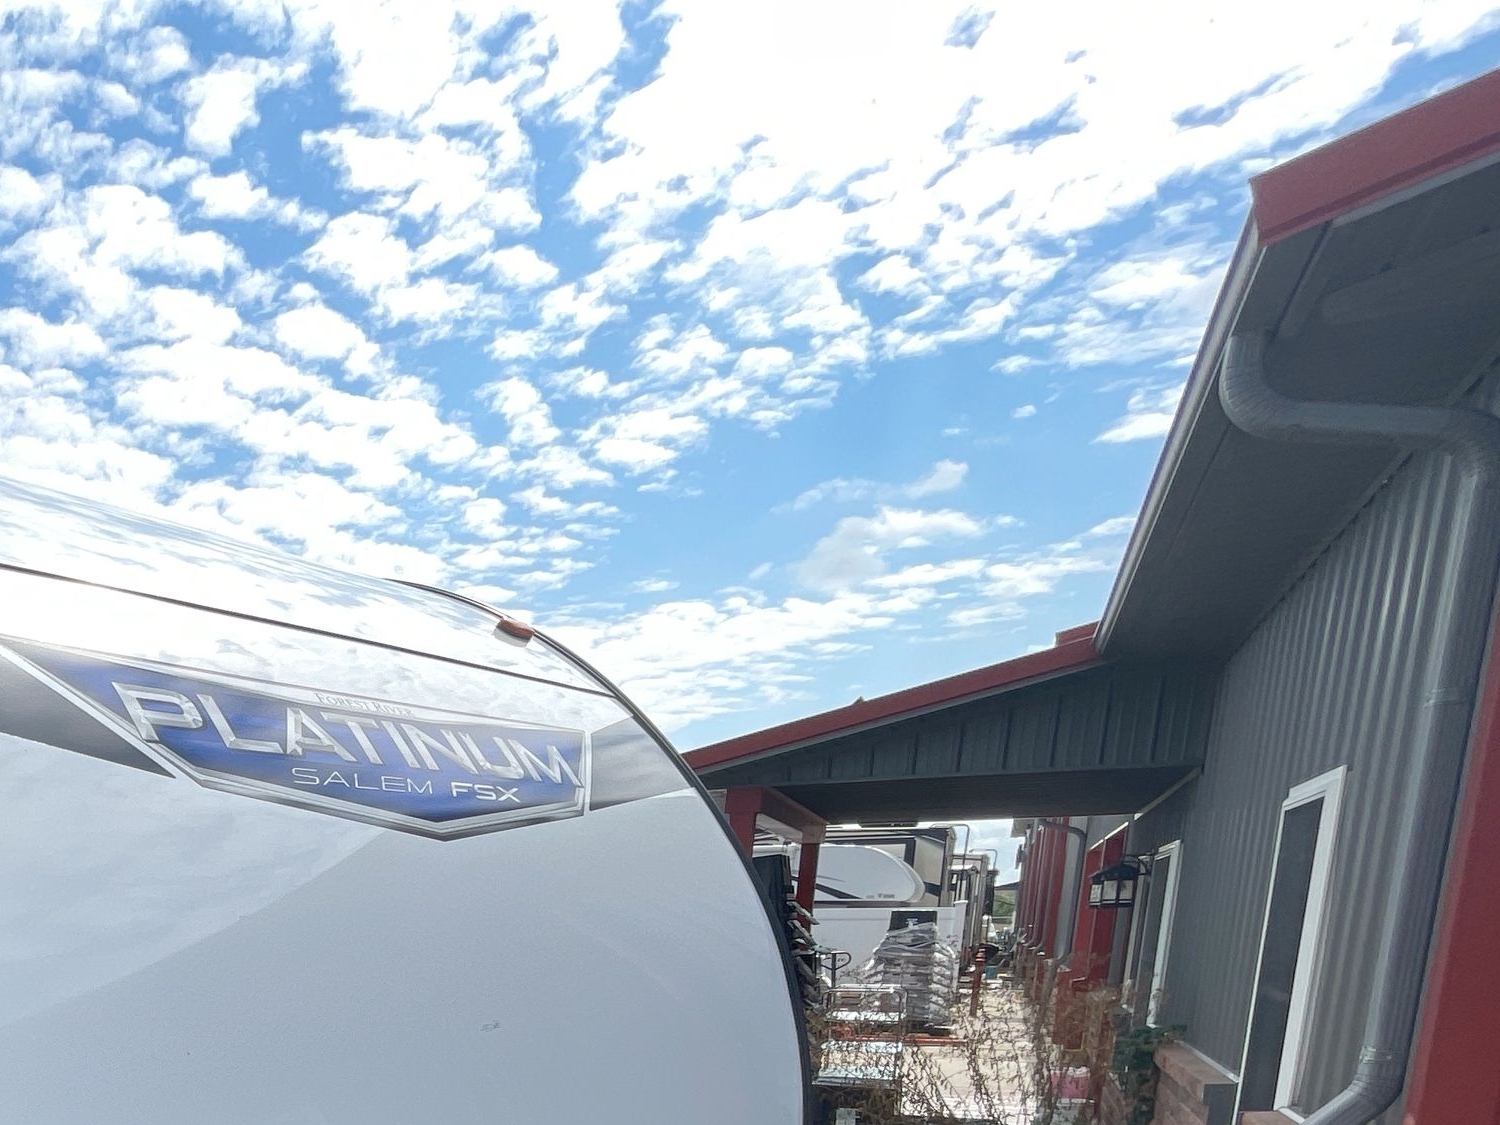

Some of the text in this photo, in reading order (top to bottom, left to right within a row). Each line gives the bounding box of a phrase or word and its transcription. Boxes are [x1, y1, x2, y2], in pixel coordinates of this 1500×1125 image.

[111, 681, 585, 788] PLATINUM
[291, 767, 522, 803] SALEM FSX
